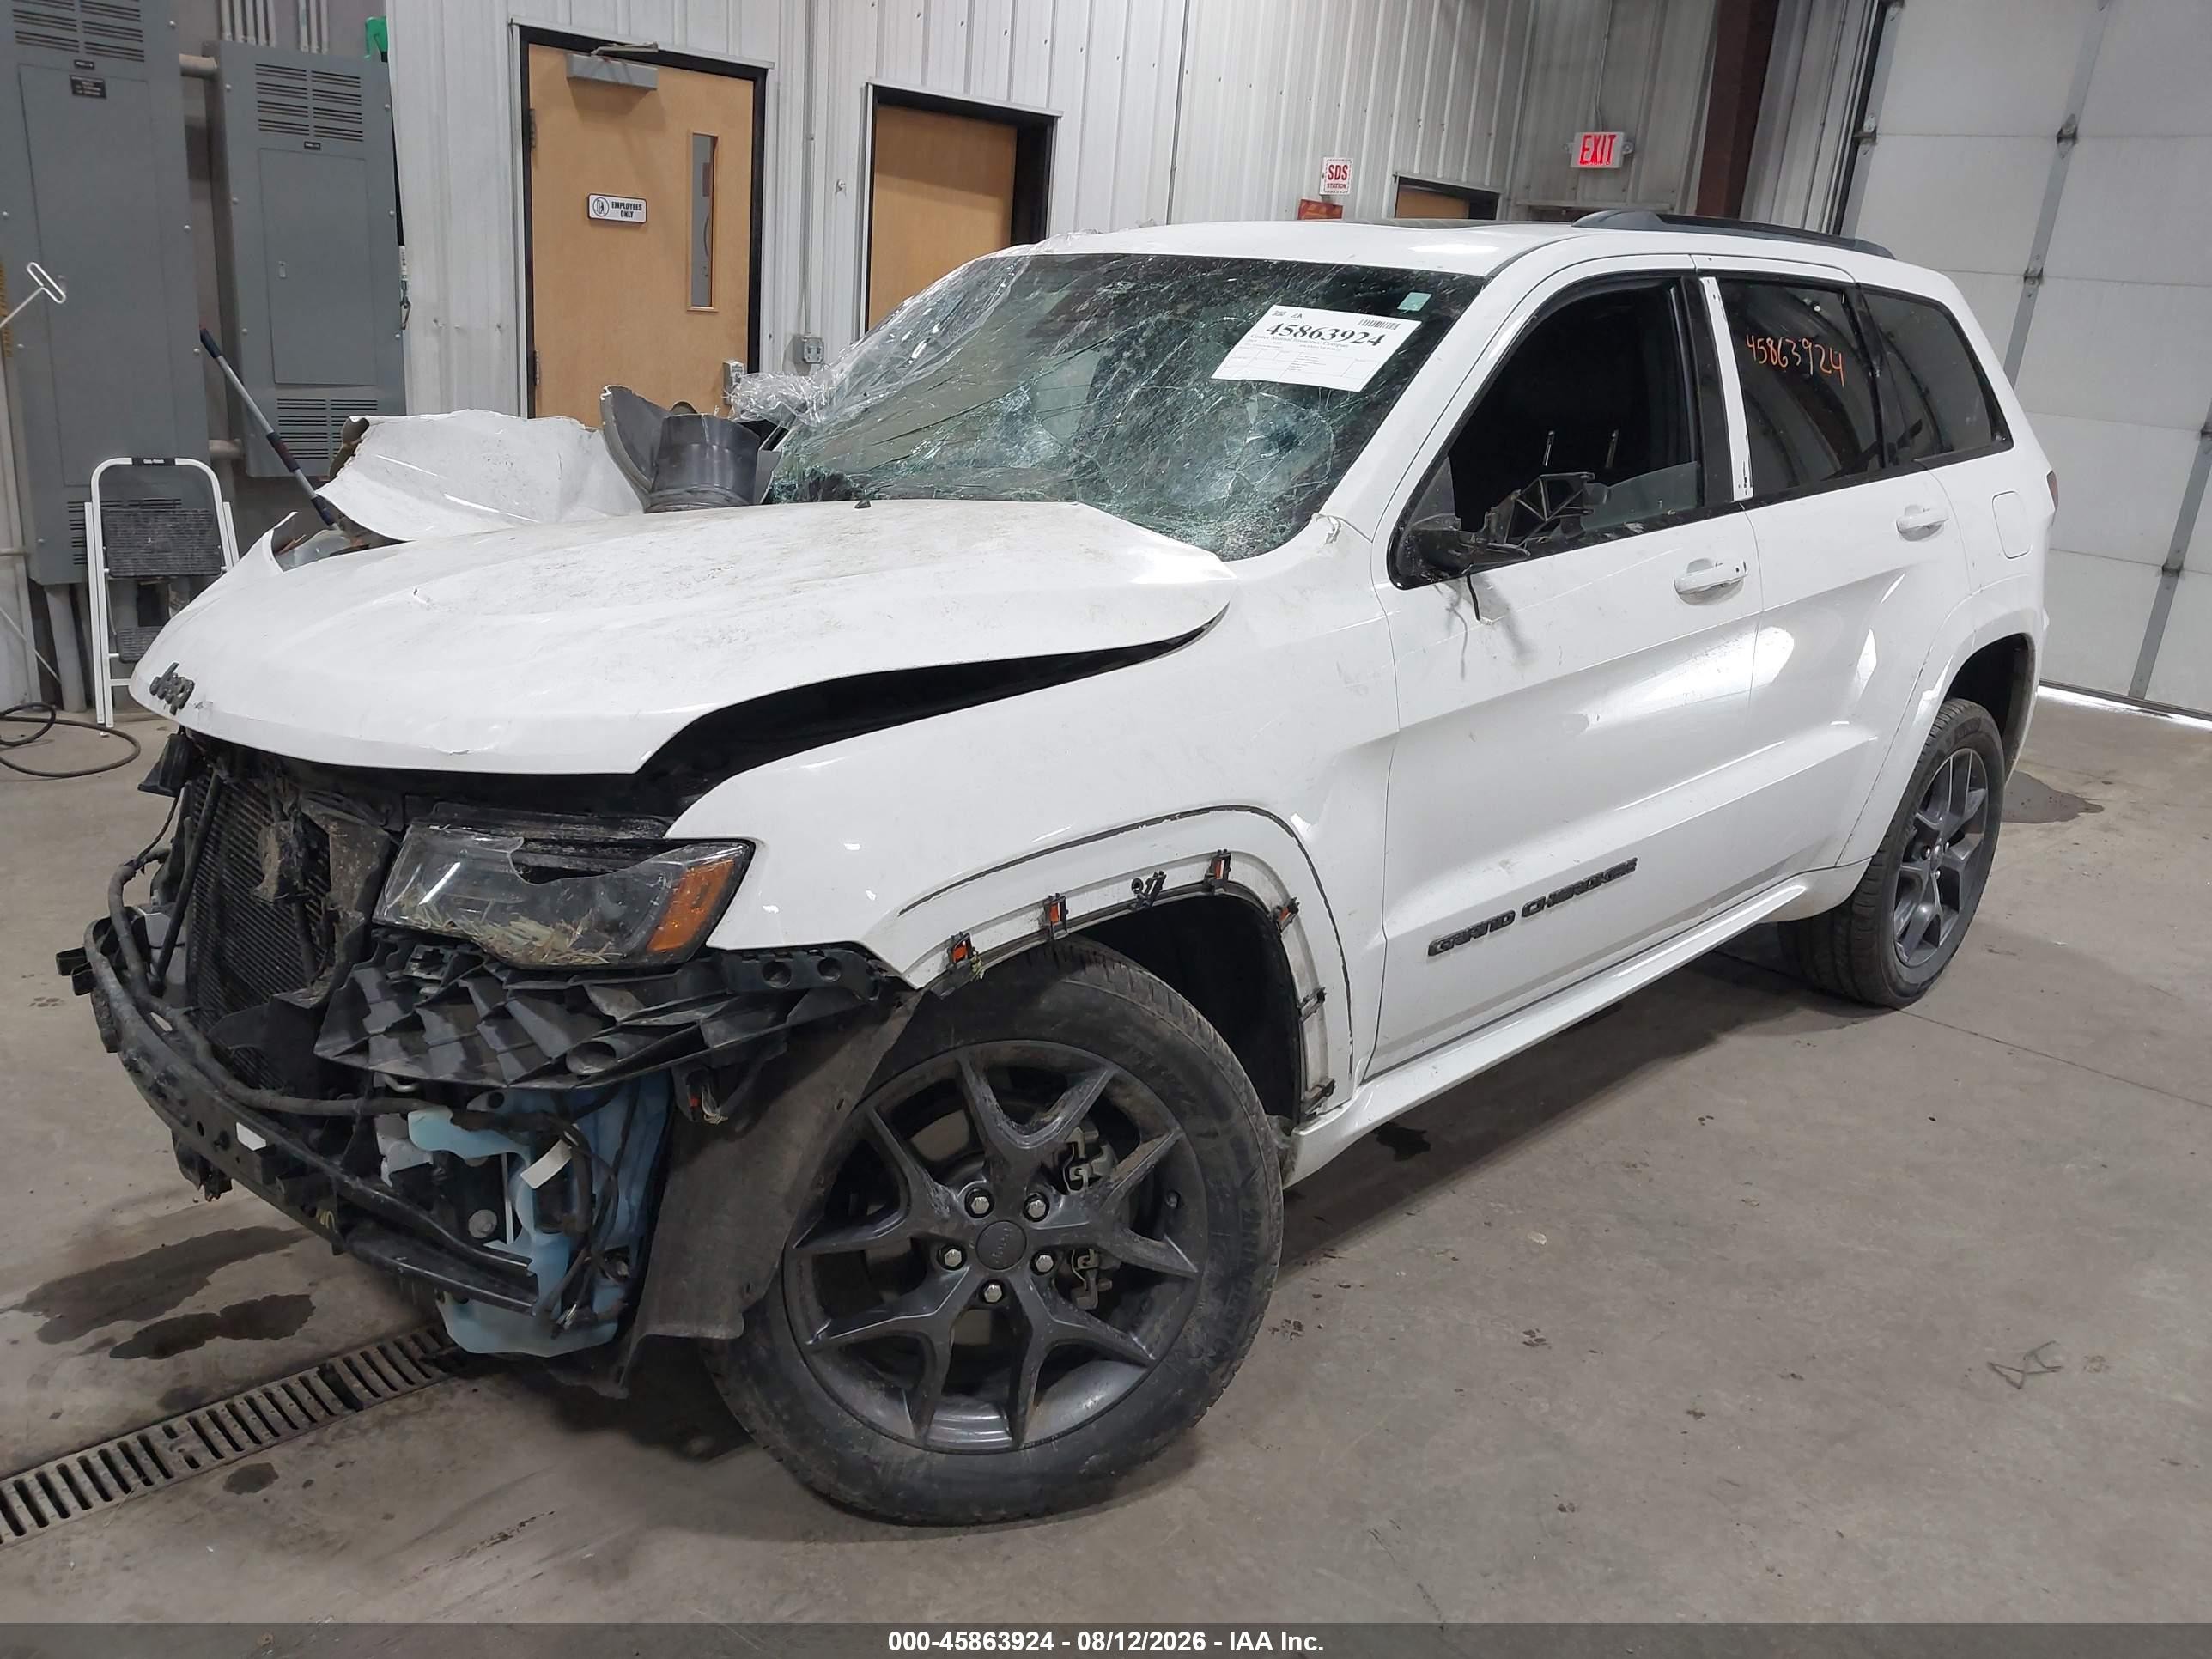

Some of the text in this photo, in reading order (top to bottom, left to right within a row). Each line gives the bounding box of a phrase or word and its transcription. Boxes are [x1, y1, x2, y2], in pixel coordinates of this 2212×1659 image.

[1580, 134, 1617, 165] EXIT
[1328, 164, 1348, 180] SDS
[611, 201, 642, 211] EMPLOYEES
[620, 210, 634, 218] ONLY
[1265, 322, 1386, 346] 45863924
[1746, 334, 1844, 387] 45863924
[1427, 857, 1638, 957] GRAND CHEROKEE
